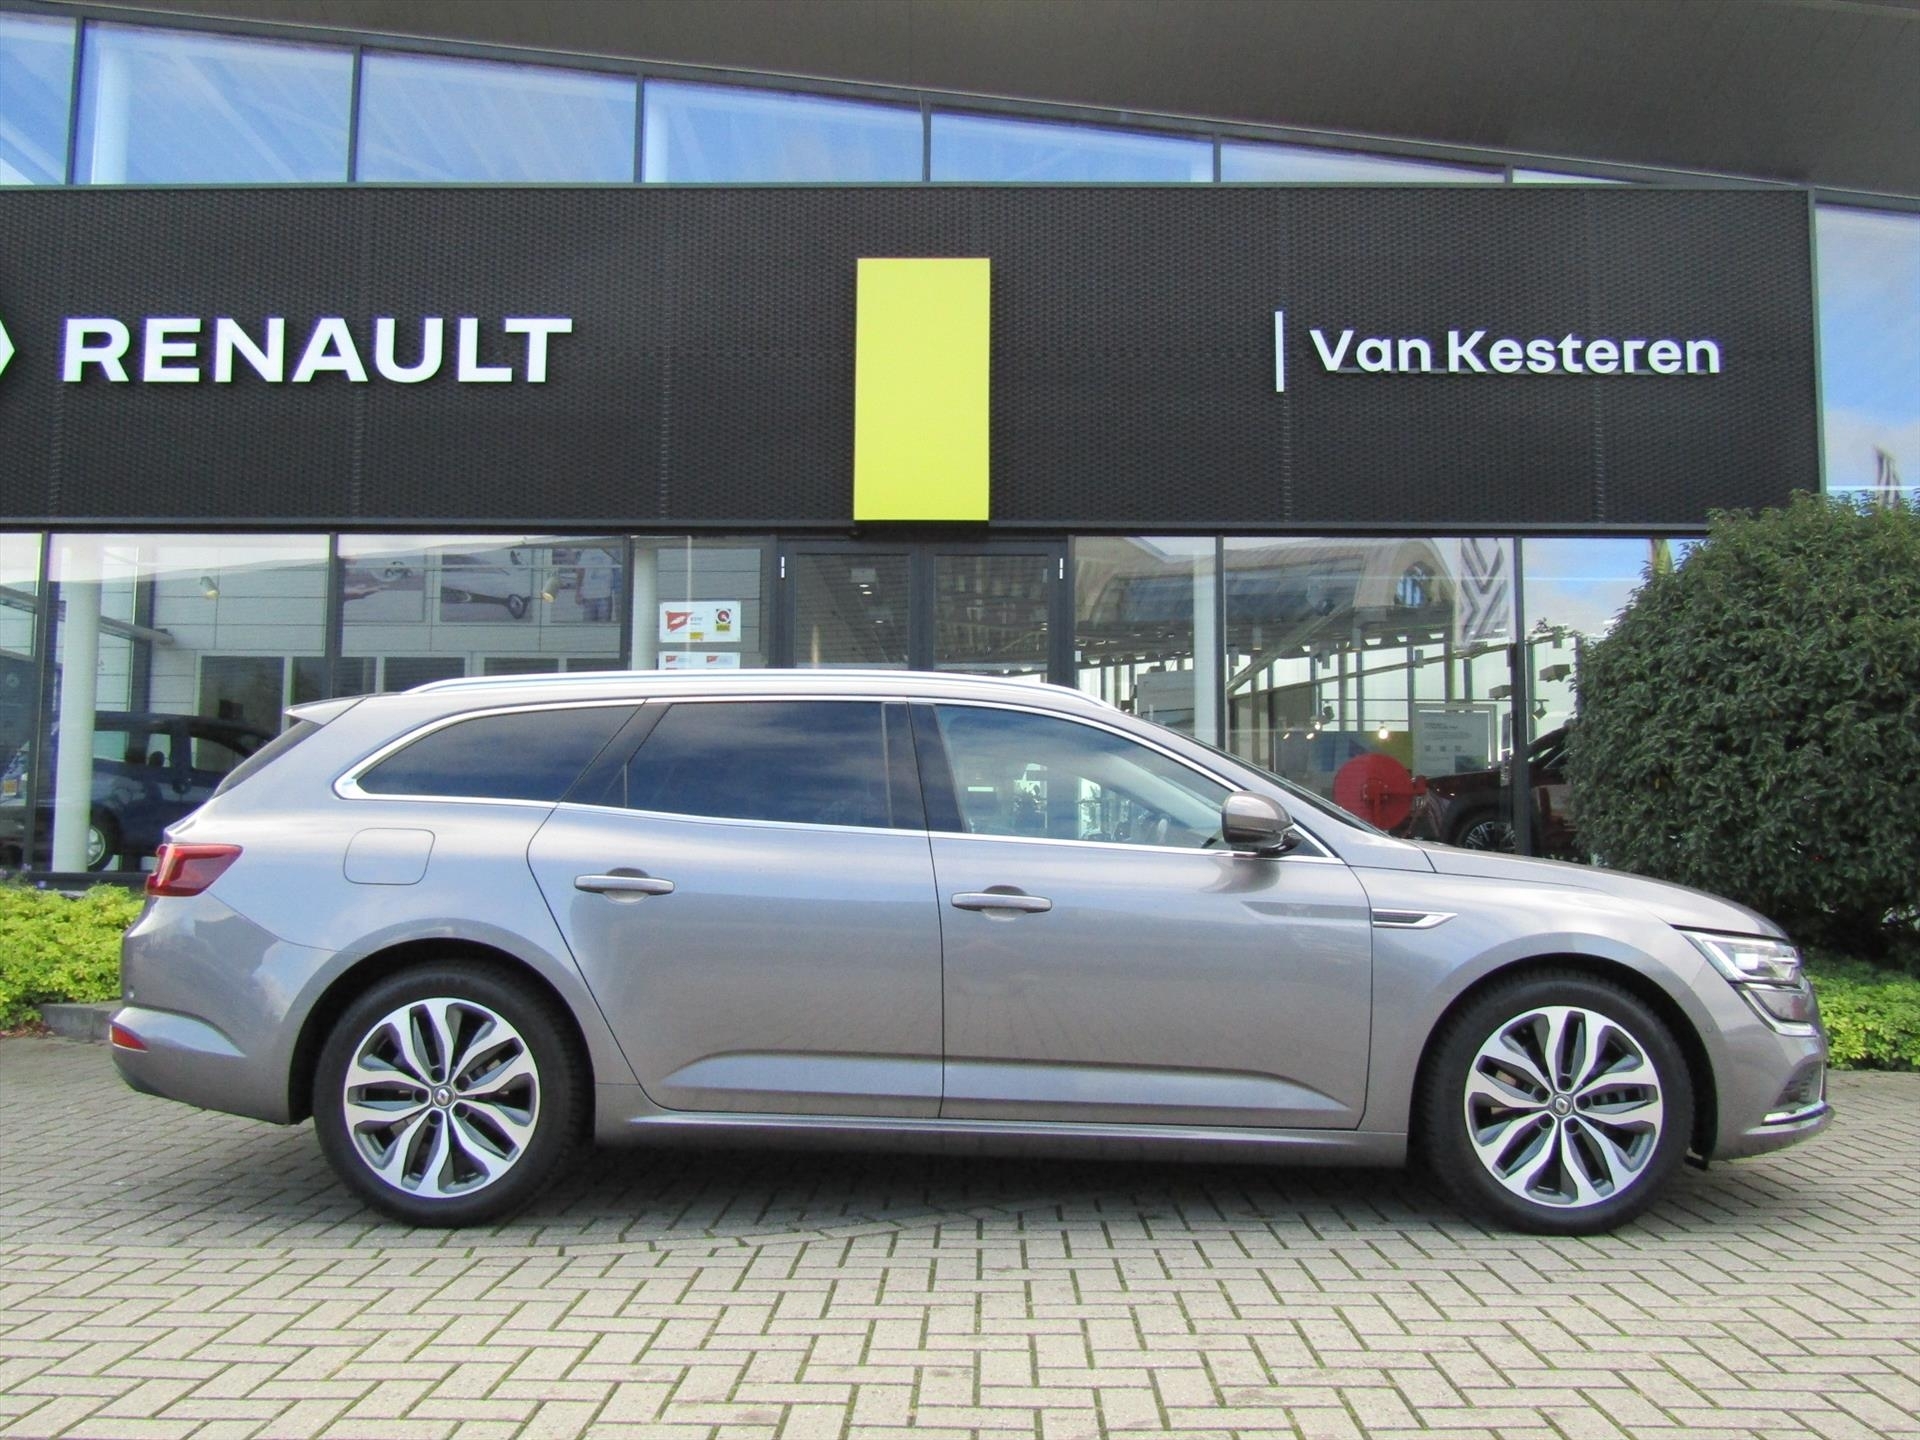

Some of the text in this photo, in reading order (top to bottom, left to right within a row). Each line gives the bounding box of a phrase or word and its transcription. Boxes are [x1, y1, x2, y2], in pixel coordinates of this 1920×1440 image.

[62, 317, 573, 384] RENAULT
[1309, 328, 1721, 375] Van Kesteren
